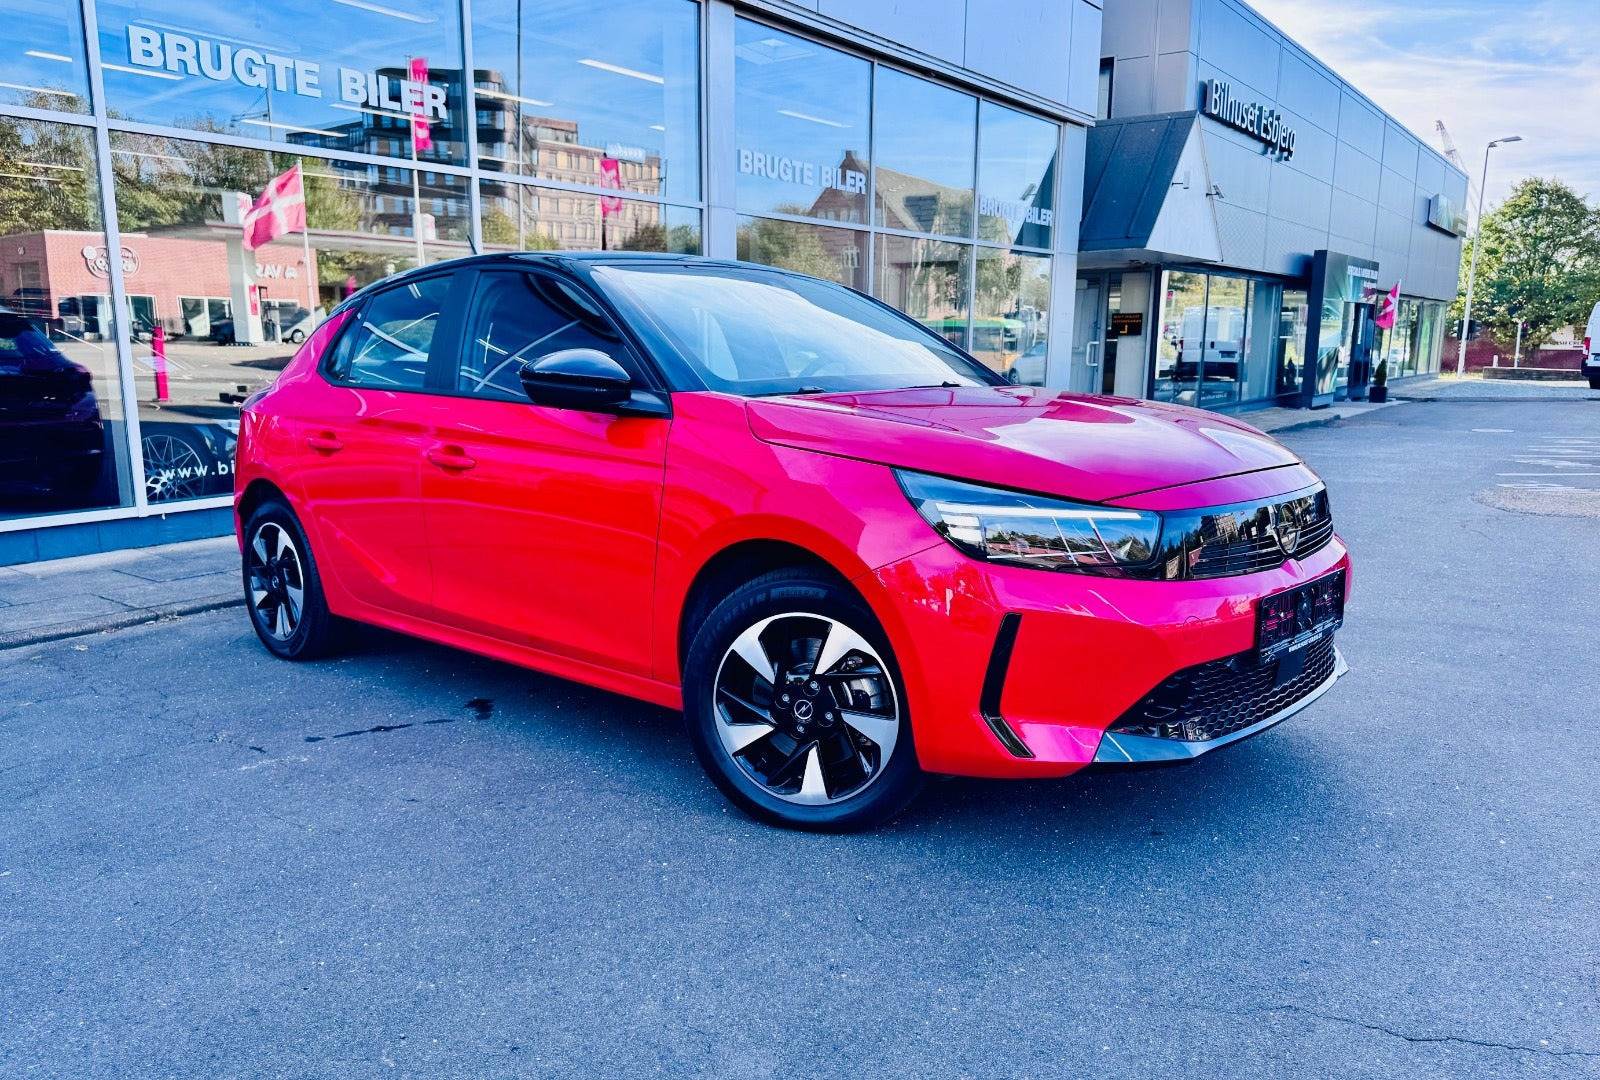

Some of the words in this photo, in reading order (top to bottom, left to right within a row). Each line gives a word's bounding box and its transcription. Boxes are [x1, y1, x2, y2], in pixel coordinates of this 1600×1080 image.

[129, 25, 322, 98] BRUGTE
[340, 67, 447, 119] BILER
[1211, 80, 1259, 135] Bilhuset
[1260, 106, 1297, 161] Esbjerg
[738, 149, 813, 185] BRUGTE
[821, 165, 866, 195] BILER
[1025, 206, 1053, 227] BILER
